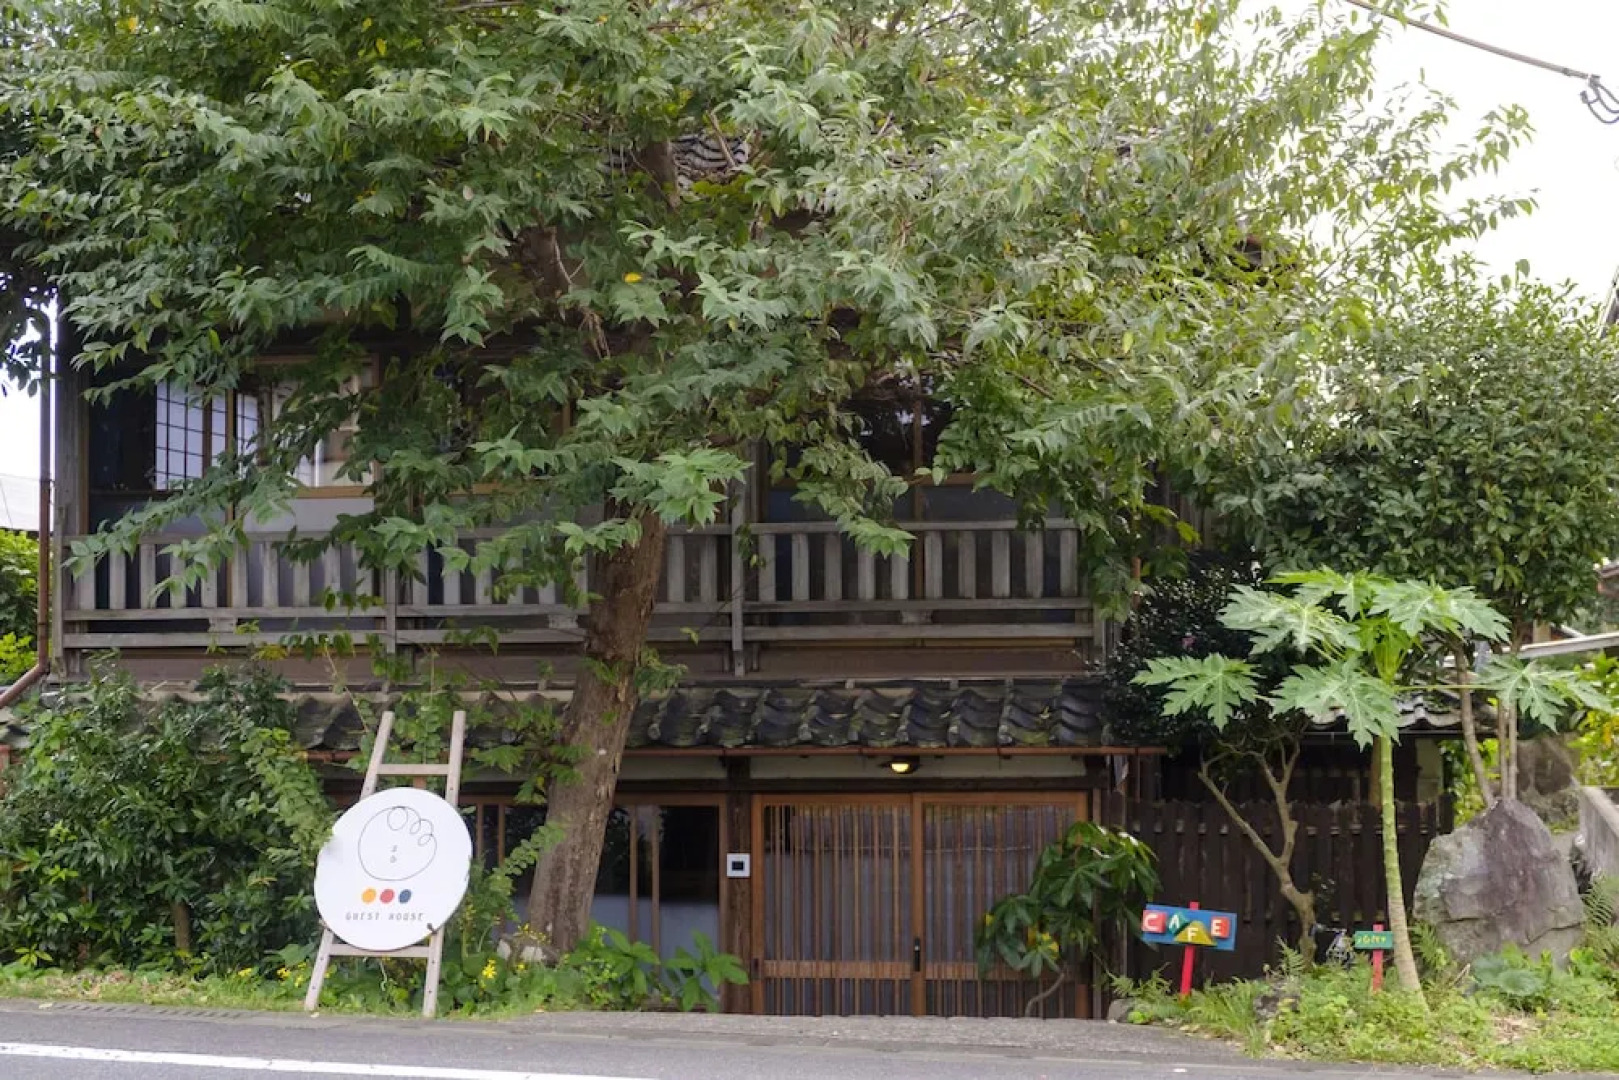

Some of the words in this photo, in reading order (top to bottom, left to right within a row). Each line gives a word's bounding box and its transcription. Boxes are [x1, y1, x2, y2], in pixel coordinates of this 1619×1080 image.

[345, 912, 380, 921] GUEST
[388, 912, 424, 921] HOUSE
[1144, 913, 1223, 942] CAFE
